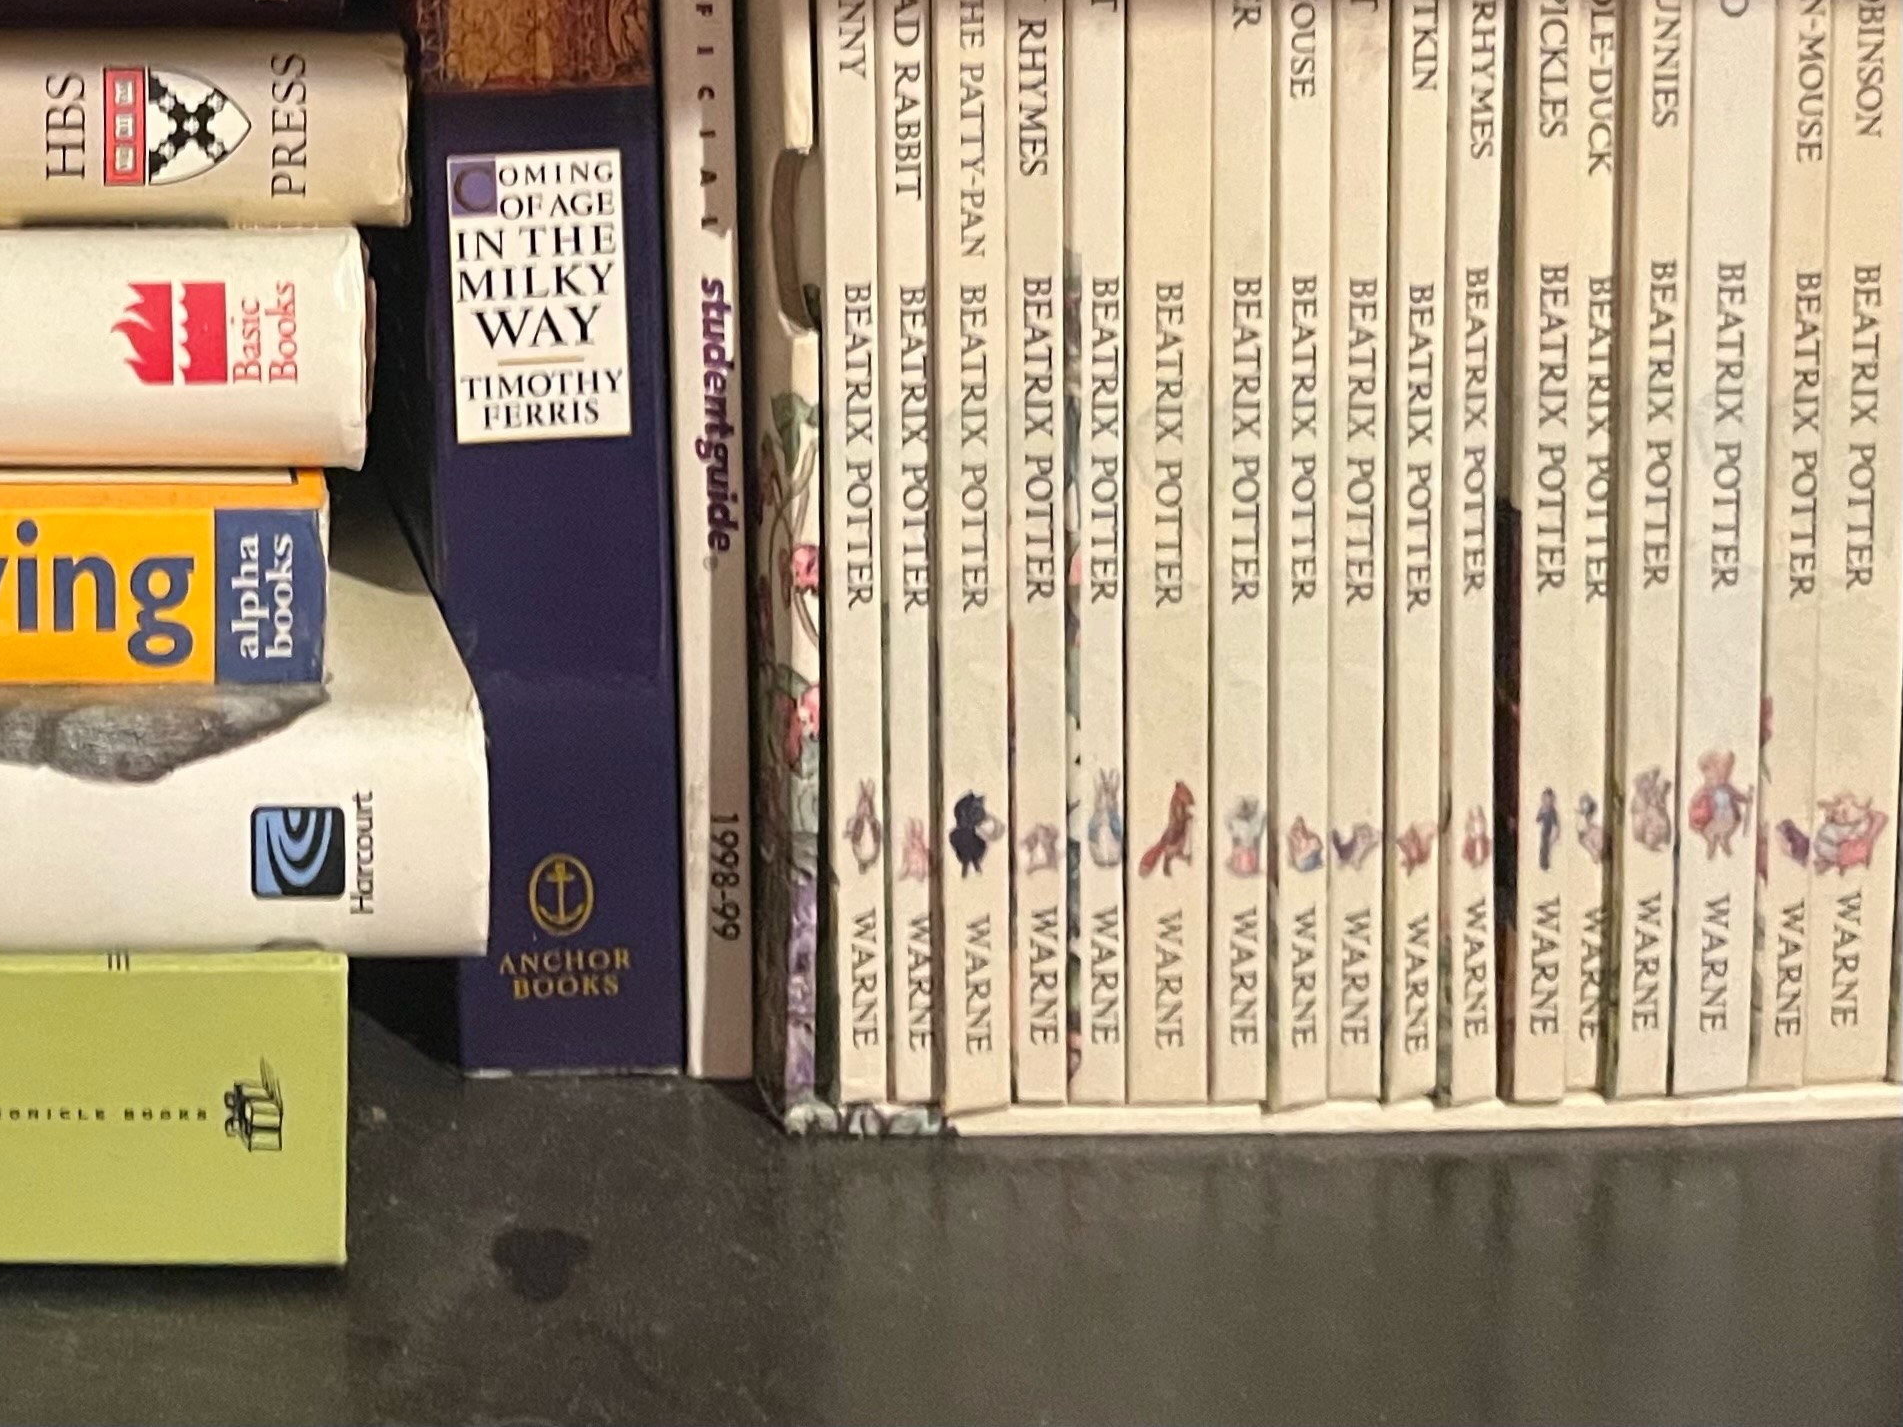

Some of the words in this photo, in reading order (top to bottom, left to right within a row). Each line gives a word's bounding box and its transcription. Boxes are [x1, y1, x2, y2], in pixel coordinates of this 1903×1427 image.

[44, 70, 87, 181] HBS
[271, 53, 307, 197] PRESS
[1018, 18, 1048, 176] RHYMES
[456, 228, 504, 261] IN
[519, 221, 617, 259] THE
[499, 193, 543, 220] OF
[550, 189, 616, 218] AGE
[230, 298, 264, 386] Basic
[268, 278, 298, 386] Books
[456, 260, 615, 303] MILKY
[471, 302, 602, 349] WAY
[1647, 260, 1677, 424] BEATRIX
[1715, 261, 1746, 425] BEATRIX
[460, 368, 623, 401] TIMOTHY
[484, 398, 600, 431] FERRIS
[695, 276, 739, 552] studentguide
[844, 283, 872, 445] BEATRIX
[1023, 276, 1053, 439] BEATRIX
[1156, 281, 1184, 445] BEATRIX
[846, 461, 874, 609] POTTER
[1025, 454, 1055, 603] POTTER
[1156, 460, 1183, 608] POTTER
[1644, 439, 1673, 590] POTTER
[1712, 441, 1742, 591] POTTER
[231, 530, 262, 661] alpha
[264, 530, 294, 661] books
[350, 789, 376, 916] Harcourt
[709, 812, 742, 943] 1998-99
[500, 947, 631, 976] ANCHOR
[514, 973, 619, 1000] BOOKS
[851, 907, 878, 1049] WARNE
[1029, 905, 1059, 1046] WARNE
[1155, 909, 1184, 1049] WARNE
[1632, 892, 1663, 1034] WARNE
[1699, 893, 1730, 1034] WARNE
